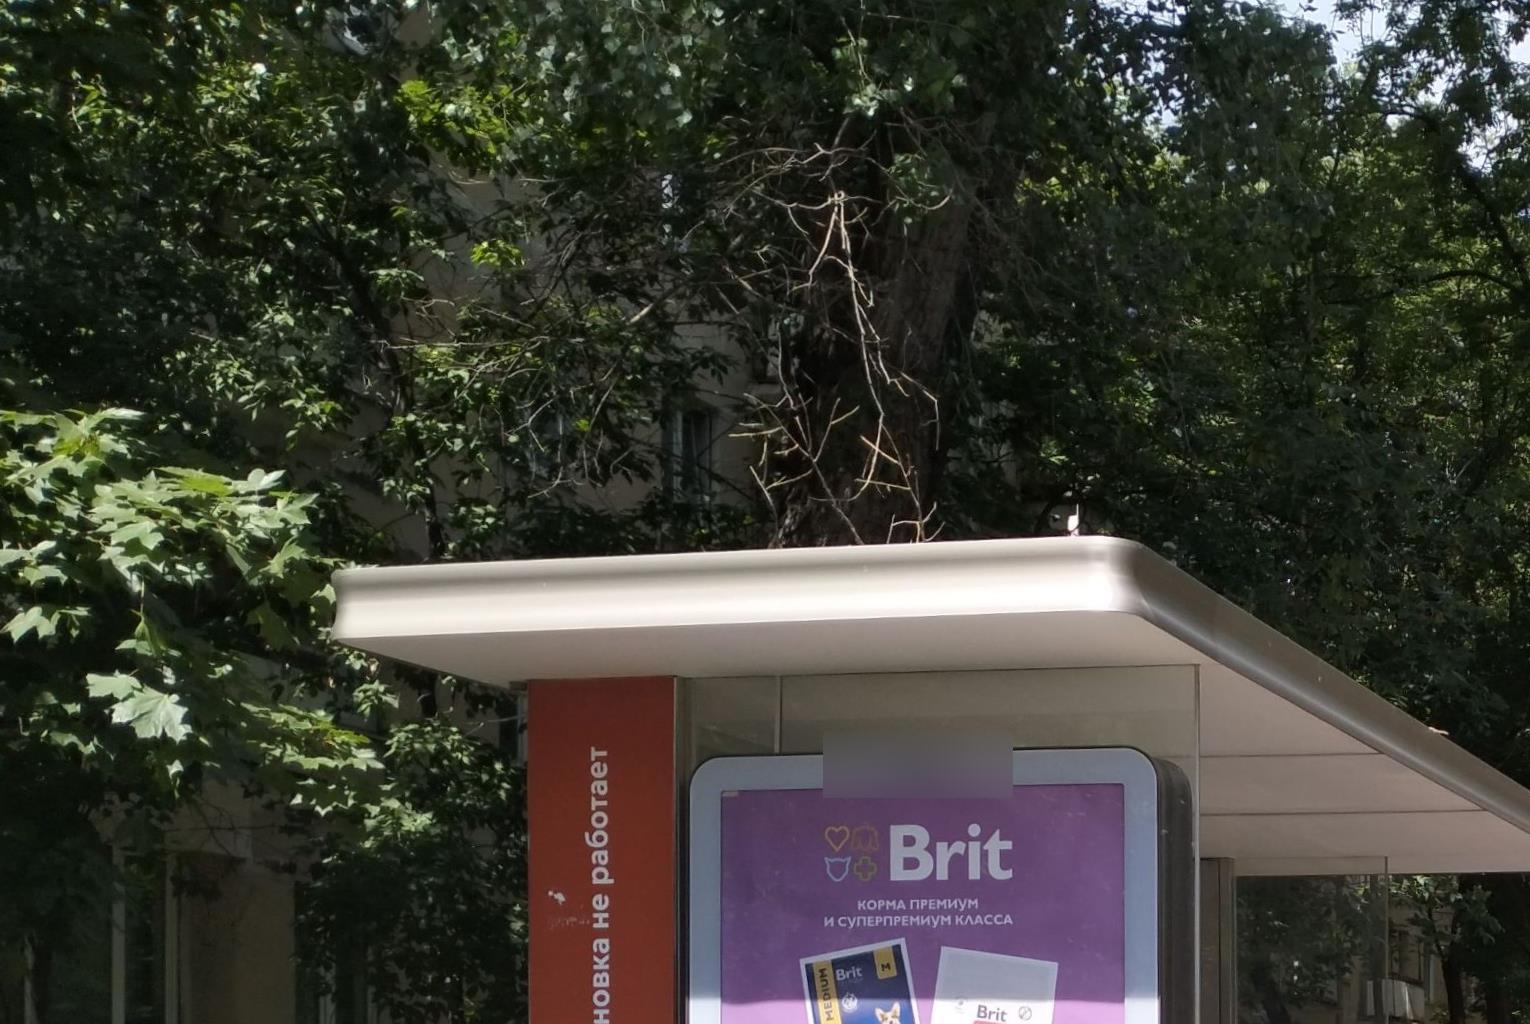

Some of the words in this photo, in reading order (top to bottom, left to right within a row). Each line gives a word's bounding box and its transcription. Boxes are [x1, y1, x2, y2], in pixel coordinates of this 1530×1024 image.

[585, 747, 614, 884] работает
[890, 823, 1013, 881] Brit
[592, 893, 609, 928] не
[857, 899, 905, 910] КОРМА
[909, 898, 978, 910] ПРЕМИУМ
[824, 916, 834, 927] И
[838, 915, 951, 929] СУПЕРПРЕМИУМ
[955, 914, 1013, 926] КЛАССА
[836, 966, 862, 981] Brit
[881, 962, 891, 972] M
[818, 967, 834, 1021] MEDIUM
[976, 1004, 1008, 1022] Brit
